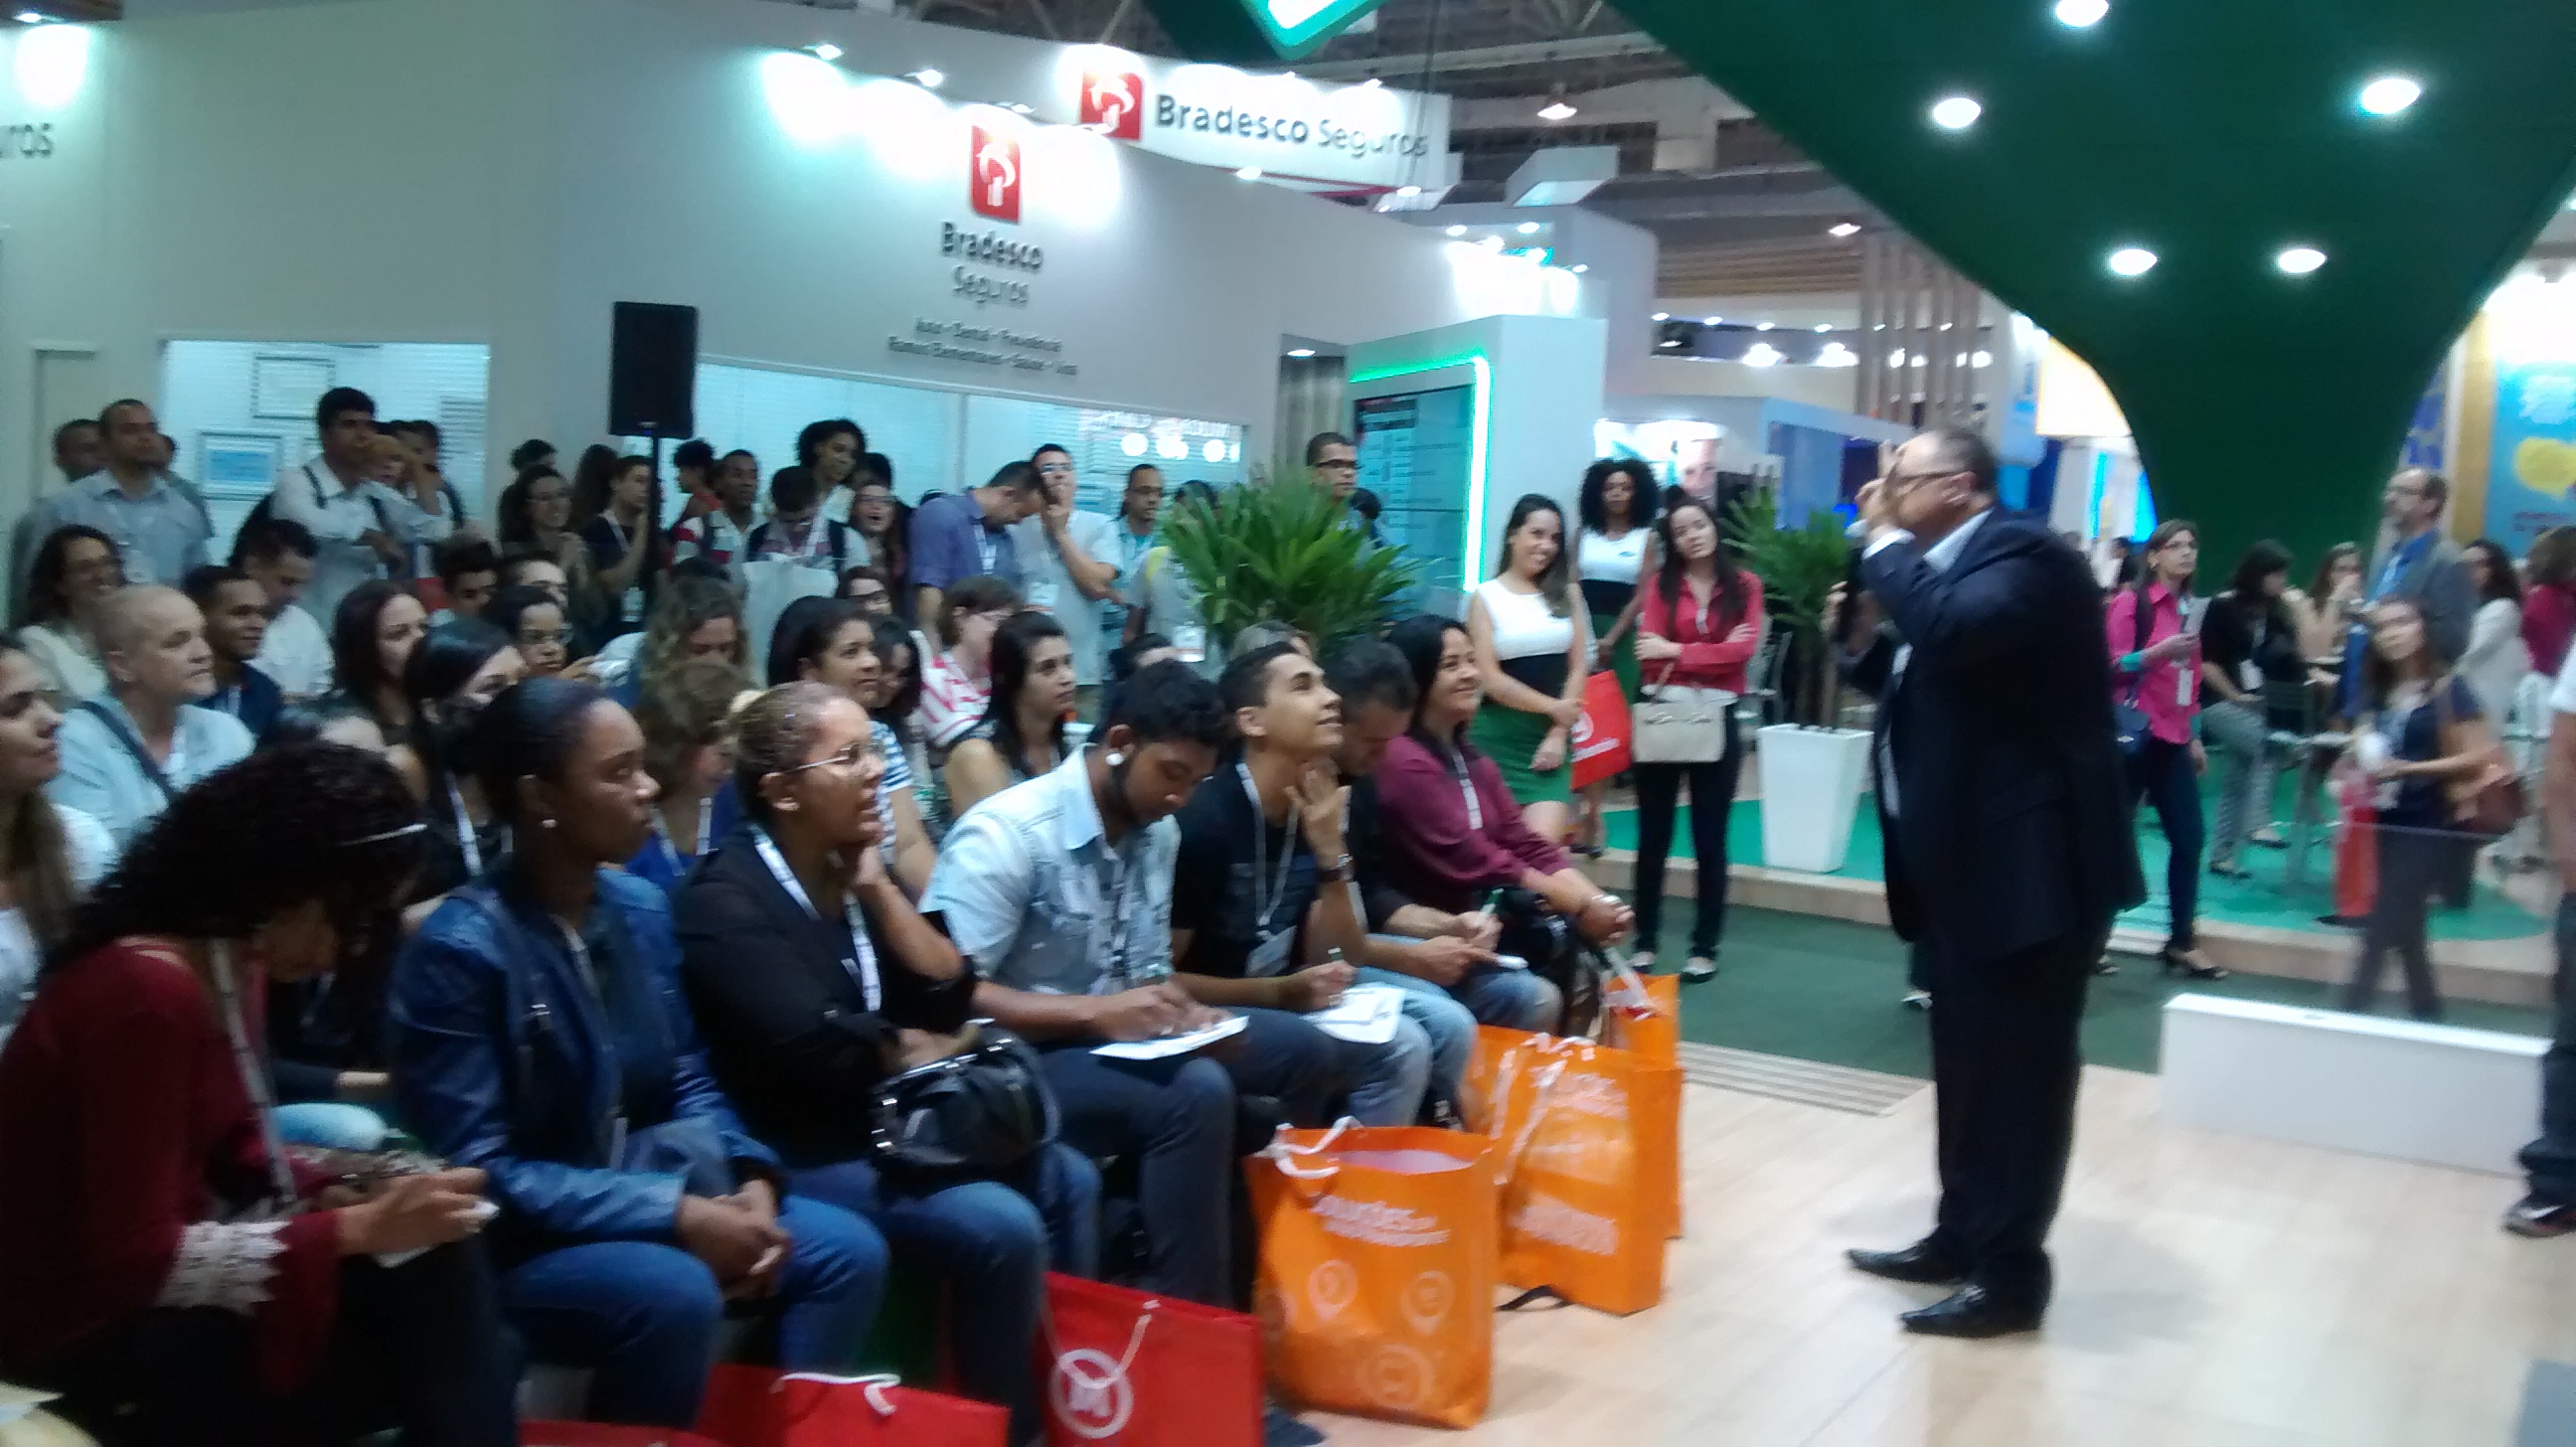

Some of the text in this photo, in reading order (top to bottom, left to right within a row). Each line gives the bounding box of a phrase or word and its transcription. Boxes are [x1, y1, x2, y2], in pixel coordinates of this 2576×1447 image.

[1155, 92, 1429, 159] Bradesco Seguros
[942, 221, 1044, 270] Bradesco
[953, 264, 1030, 306] Seguros
